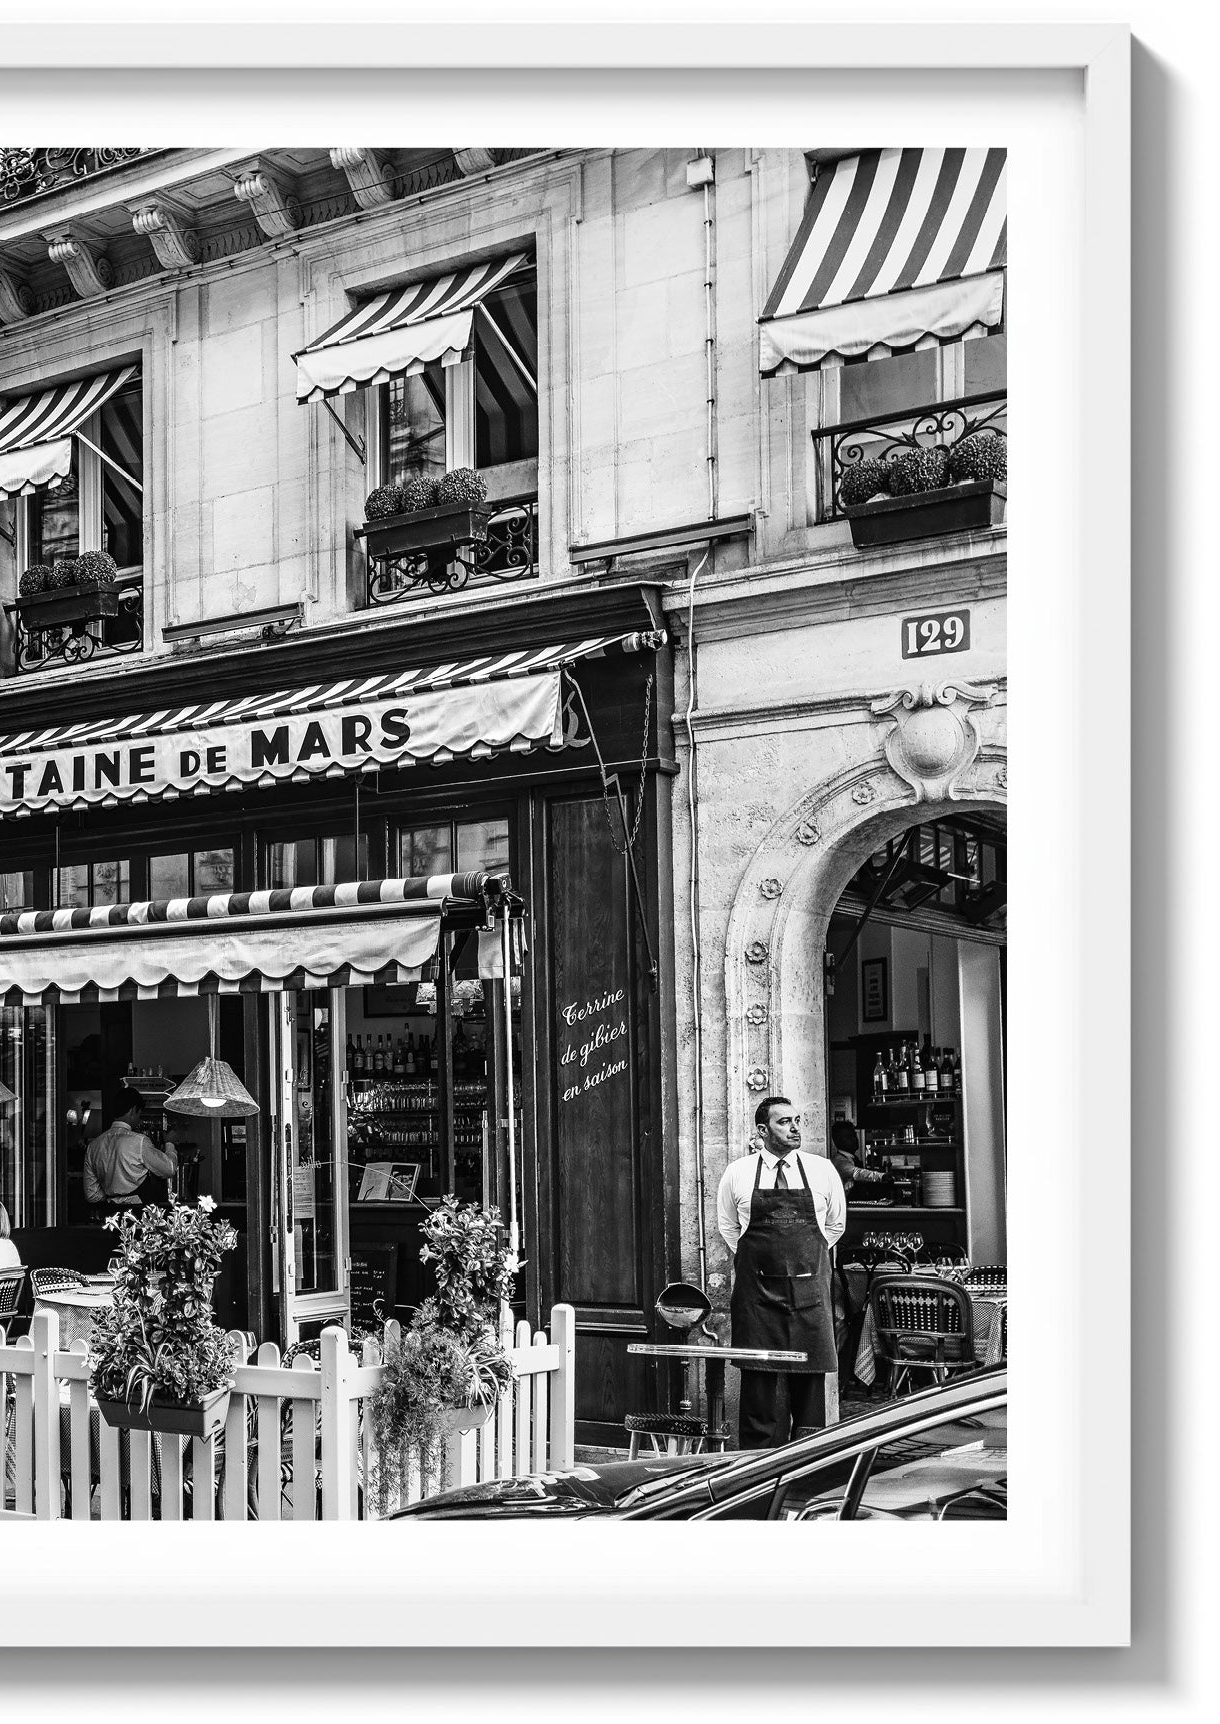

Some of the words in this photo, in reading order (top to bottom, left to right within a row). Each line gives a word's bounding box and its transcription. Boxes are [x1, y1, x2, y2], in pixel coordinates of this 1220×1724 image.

[907, 616, 965, 654] 129
[180, 745, 227, 778] DE
[250, 708, 411, 768] MARS
[561, 989, 625, 1026] Terrine
[561, 1044, 578, 1066] de
[580, 1020, 628, 1067] gibier
[561, 1085, 582, 1102] en
[583, 1059, 628, 1091] saison
